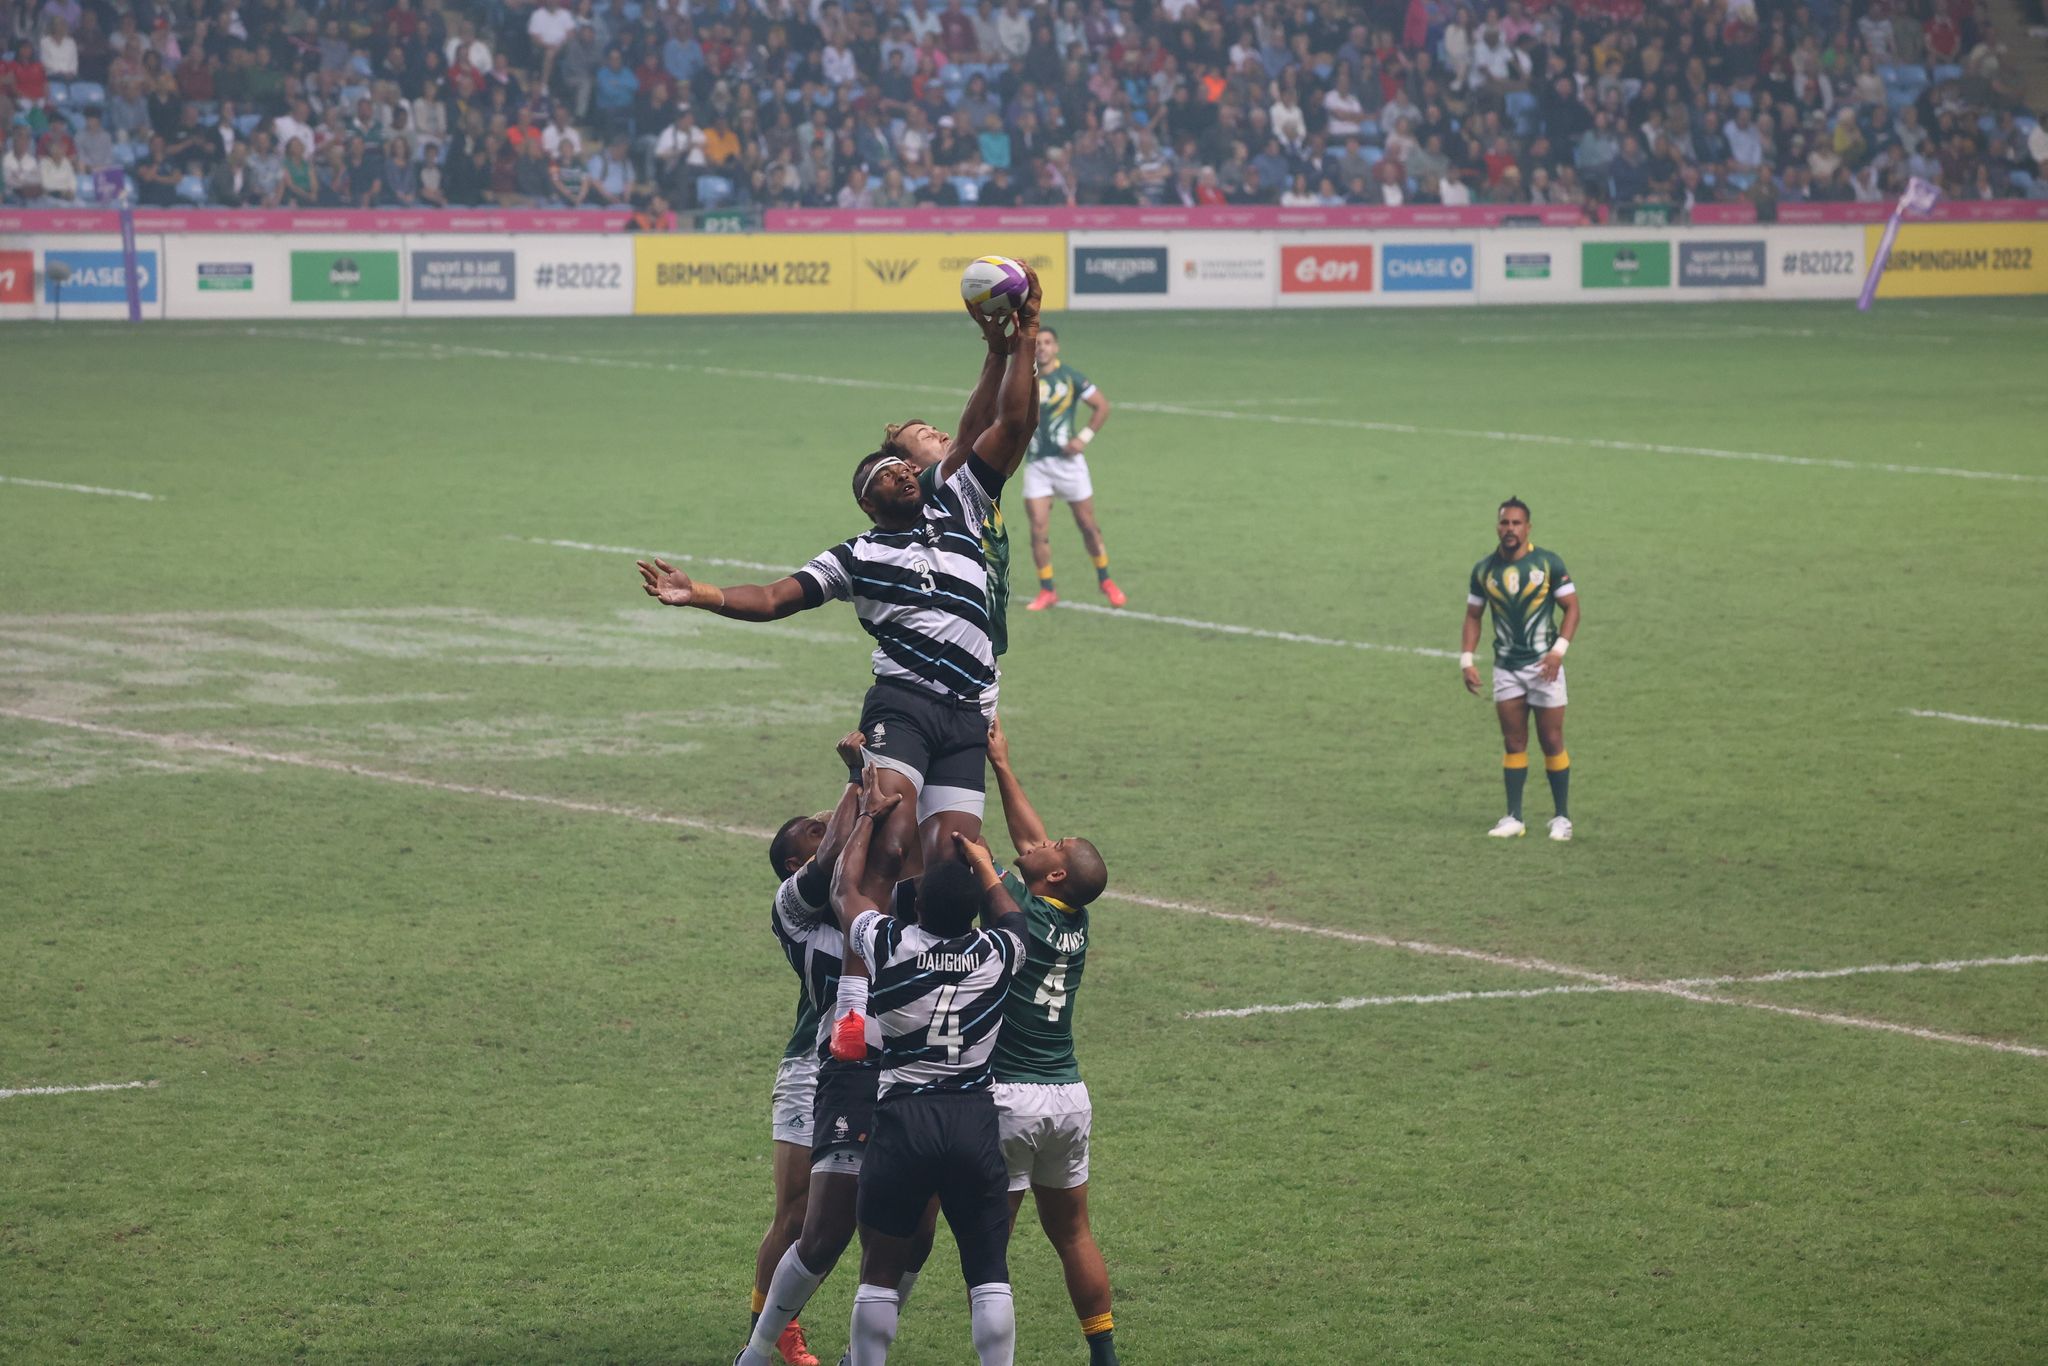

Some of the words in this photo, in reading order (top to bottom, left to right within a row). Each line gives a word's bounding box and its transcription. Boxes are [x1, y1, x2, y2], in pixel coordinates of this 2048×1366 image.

[1387, 258, 1448, 278] CHASE
[1992, 247, 2033, 270] 2022
[657, 261, 778, 286] BIRMINGHAM
[783, 261, 830, 285] 2022
[913, 559, 937, 594] 3
[1046, 923, 1057, 944] Z
[916, 951, 980, 973] DAUGUNU
[1033, 956, 1069, 1022] 4
[926, 984, 964, 1065] 4
